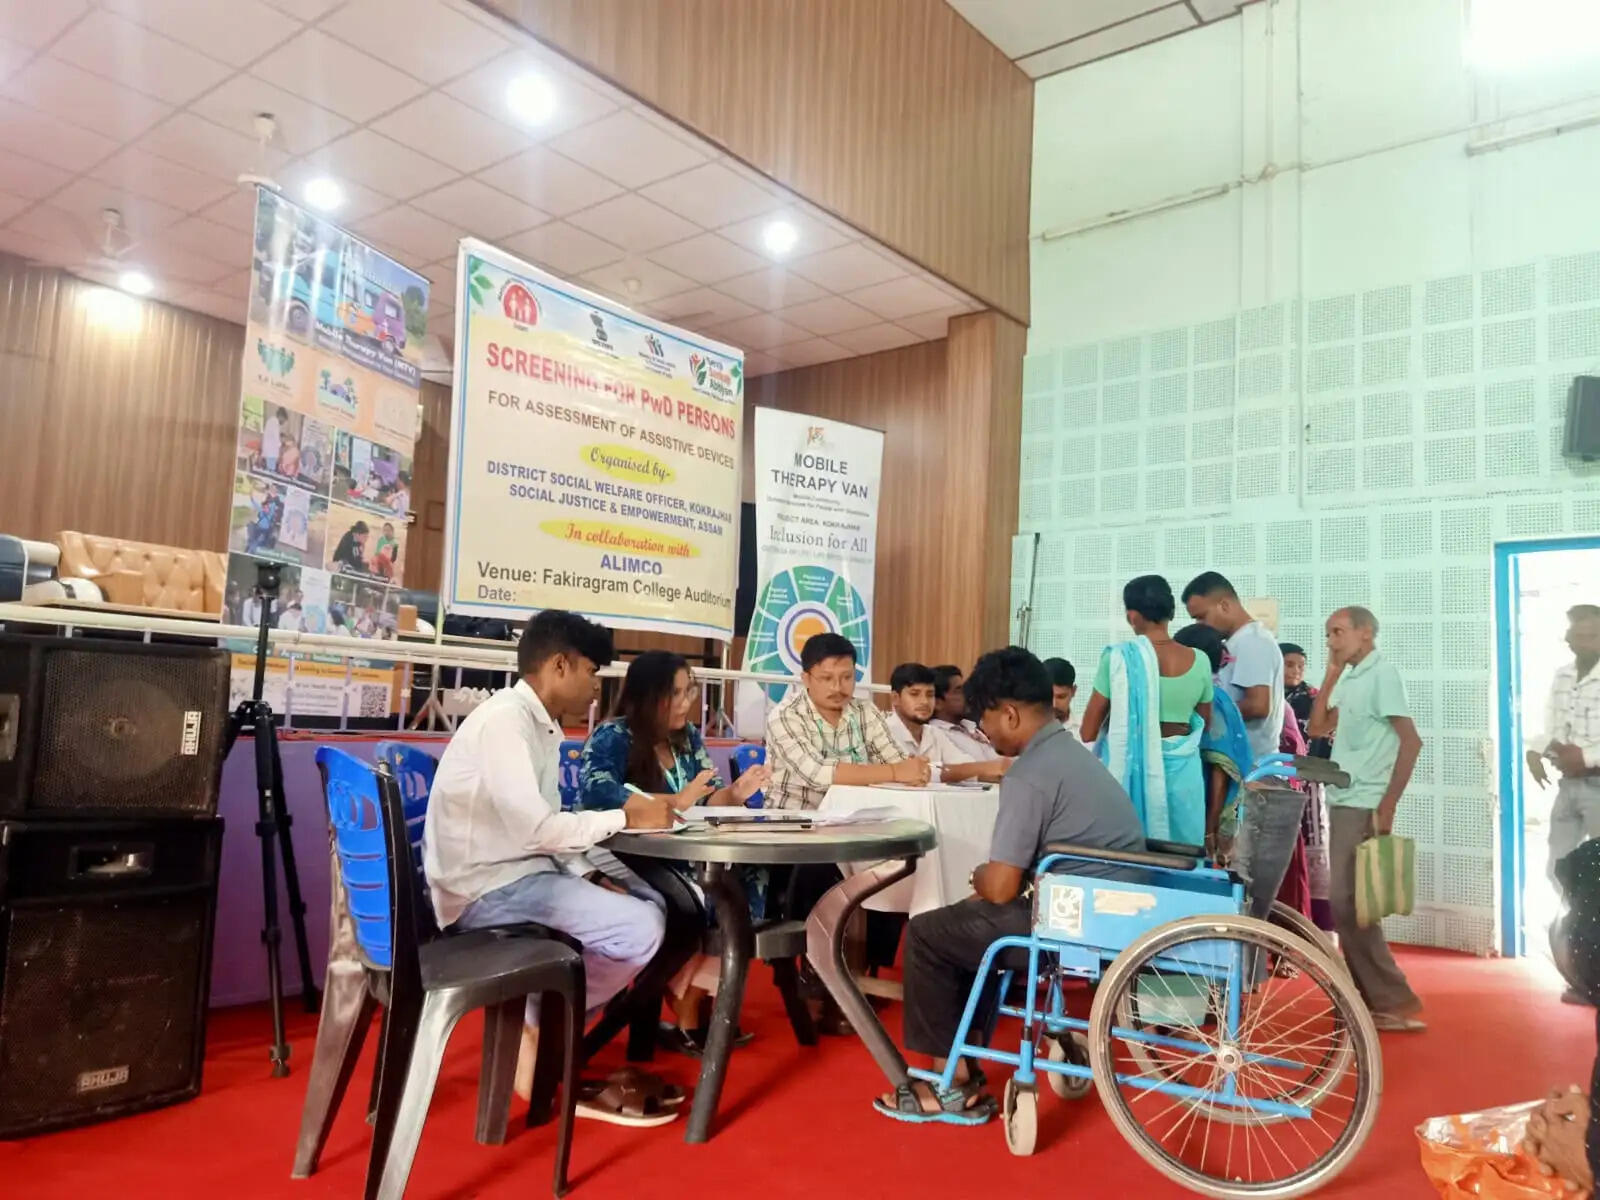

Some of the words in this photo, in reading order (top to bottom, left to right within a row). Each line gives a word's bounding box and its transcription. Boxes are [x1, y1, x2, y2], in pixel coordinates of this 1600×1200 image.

[488, 390, 520, 411] FOR
[525, 395, 616, 433] ASSESSMENT
[620, 423, 636, 439] OF
[640, 429, 695, 456] ASSISTIVE
[697, 446, 735, 470] DEVICES
[641, 388, 672, 417] PwD
[677, 396, 736, 440] PERSONS
[590, 446, 650, 475] Organised
[794, 452, 848, 475] MOBILE
[487, 460, 546, 483] DISTRICT
[550, 472, 592, 492] SOCIAL
[595, 482, 643, 502] WELFARE
[646, 491, 688, 512] OFFICER,
[771, 469, 837, 494] THERAPY
[841, 481, 868, 499] VAN
[509, 484, 555, 503] SOCIAL
[558, 492, 606, 512] JUSTICE
[610, 502, 618, 514] &
[621, 504, 697, 532] EMPOWERMENT,
[565, 522, 582, 541] In
[585, 529, 664, 554] collaboration
[666, 541, 690, 558] with
[827, 532, 847, 550] for
[851, 537, 867, 552] All
[600, 554, 662, 576] ALIMCO
[477, 561, 537, 583] Venue:
[543, 568, 628, 595] Fakiragram
[633, 579, 681, 603] College
[478, 584, 516, 602] Date:
[184, 711, 200, 755] AHUJA
[80, 1067, 129, 1090] AHUJA
